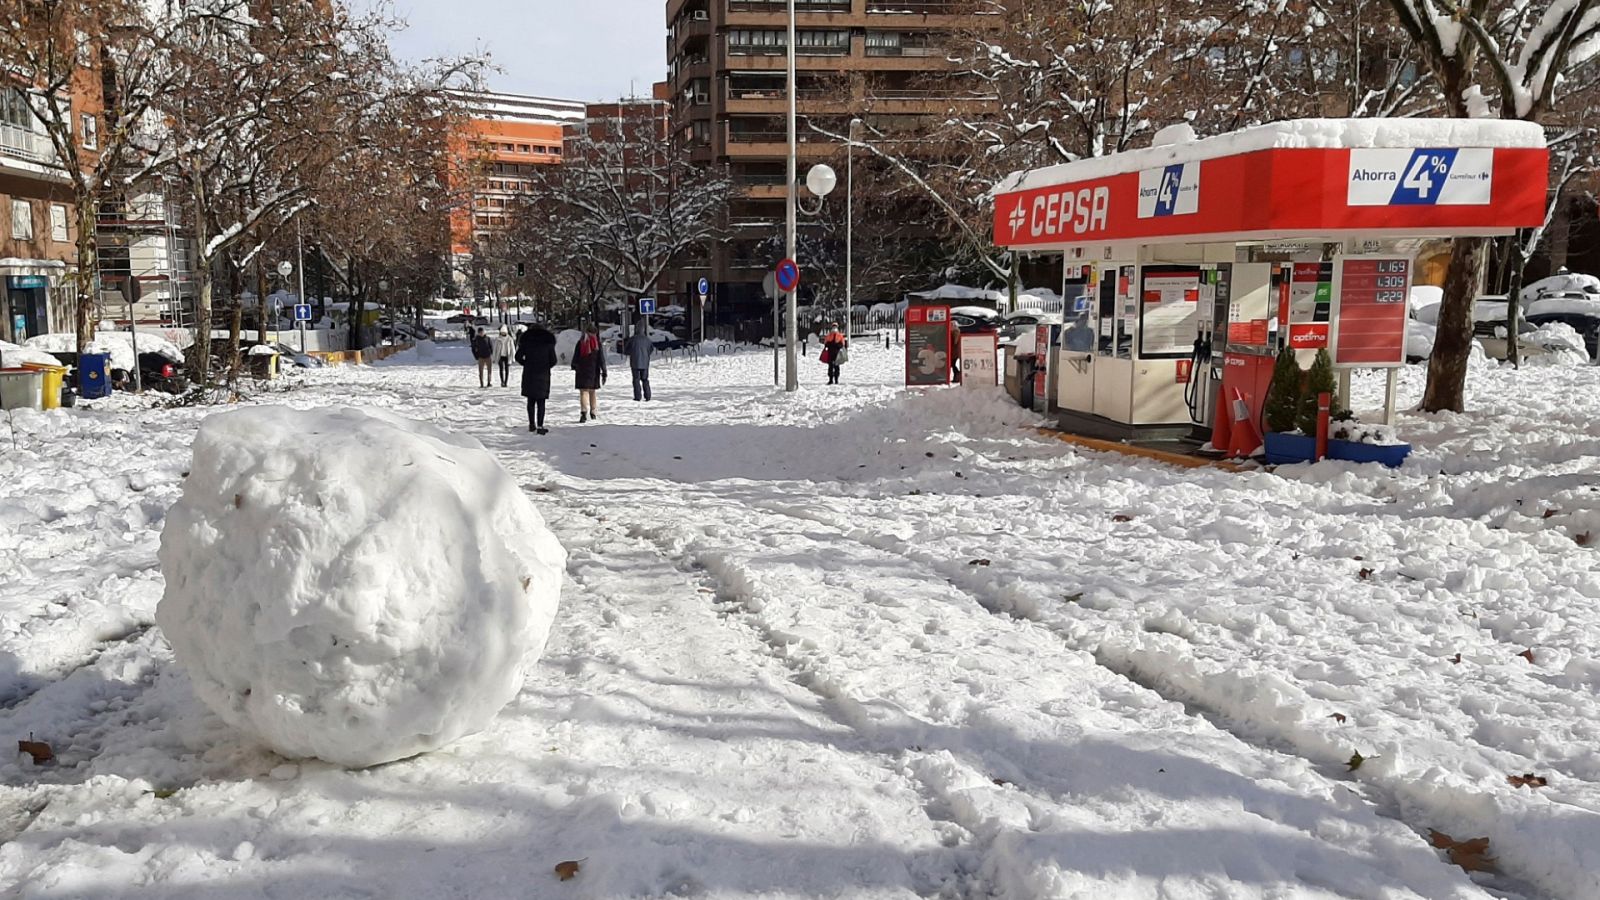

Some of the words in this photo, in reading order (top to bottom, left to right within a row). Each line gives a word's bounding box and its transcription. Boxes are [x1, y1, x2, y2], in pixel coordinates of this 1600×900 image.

[1352, 169, 1396, 181] Ahorra
[1140, 187, 1157, 197] Ahorra
[1031, 186, 1109, 237] CEPSA
[1379, 261, 1406, 273] 1.169
[1377, 276, 1404, 288] 1.309
[1376, 291, 1403, 303] 1.229
[1293, 332, 1325, 343] optima
